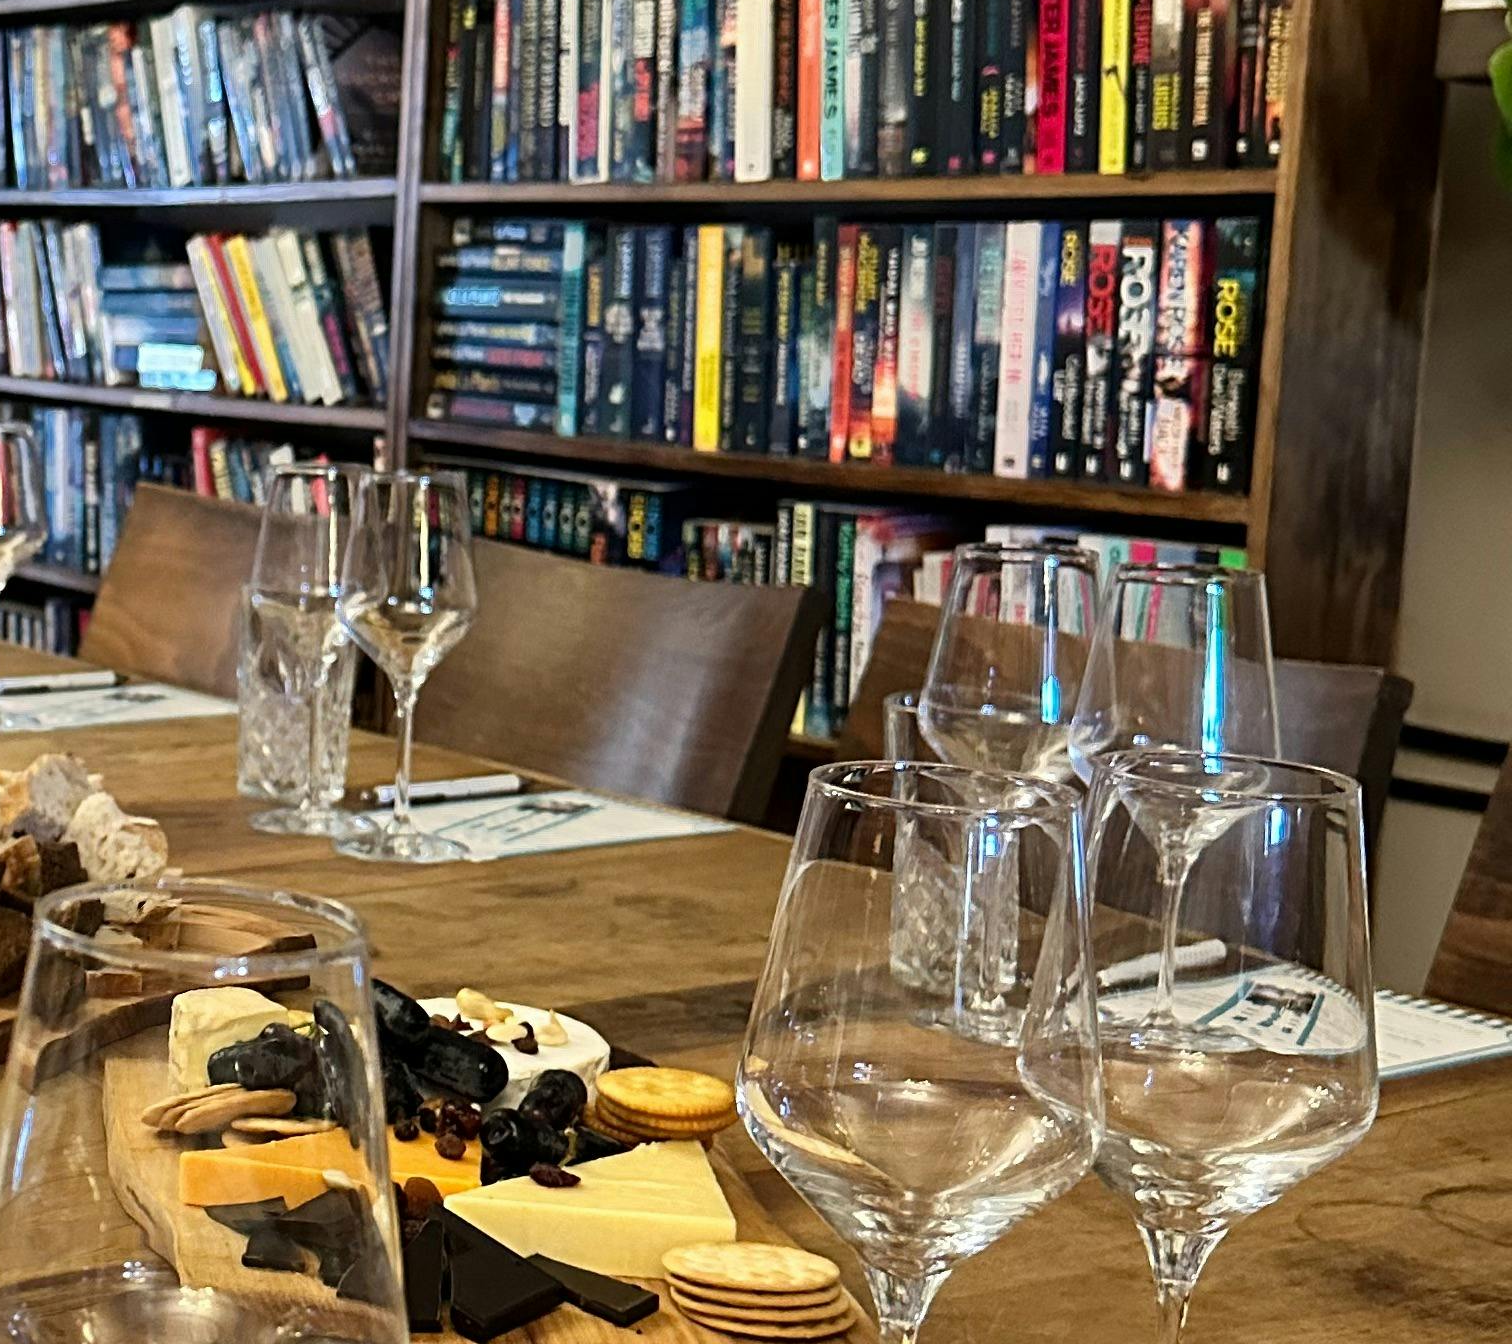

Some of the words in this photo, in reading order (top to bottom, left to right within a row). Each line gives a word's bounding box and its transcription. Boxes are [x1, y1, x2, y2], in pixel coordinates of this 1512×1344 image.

[823, 36, 840, 120] JAMES
[1088, 244, 1115, 336] ROSE
[1214, 278, 1238, 358] ROSE
